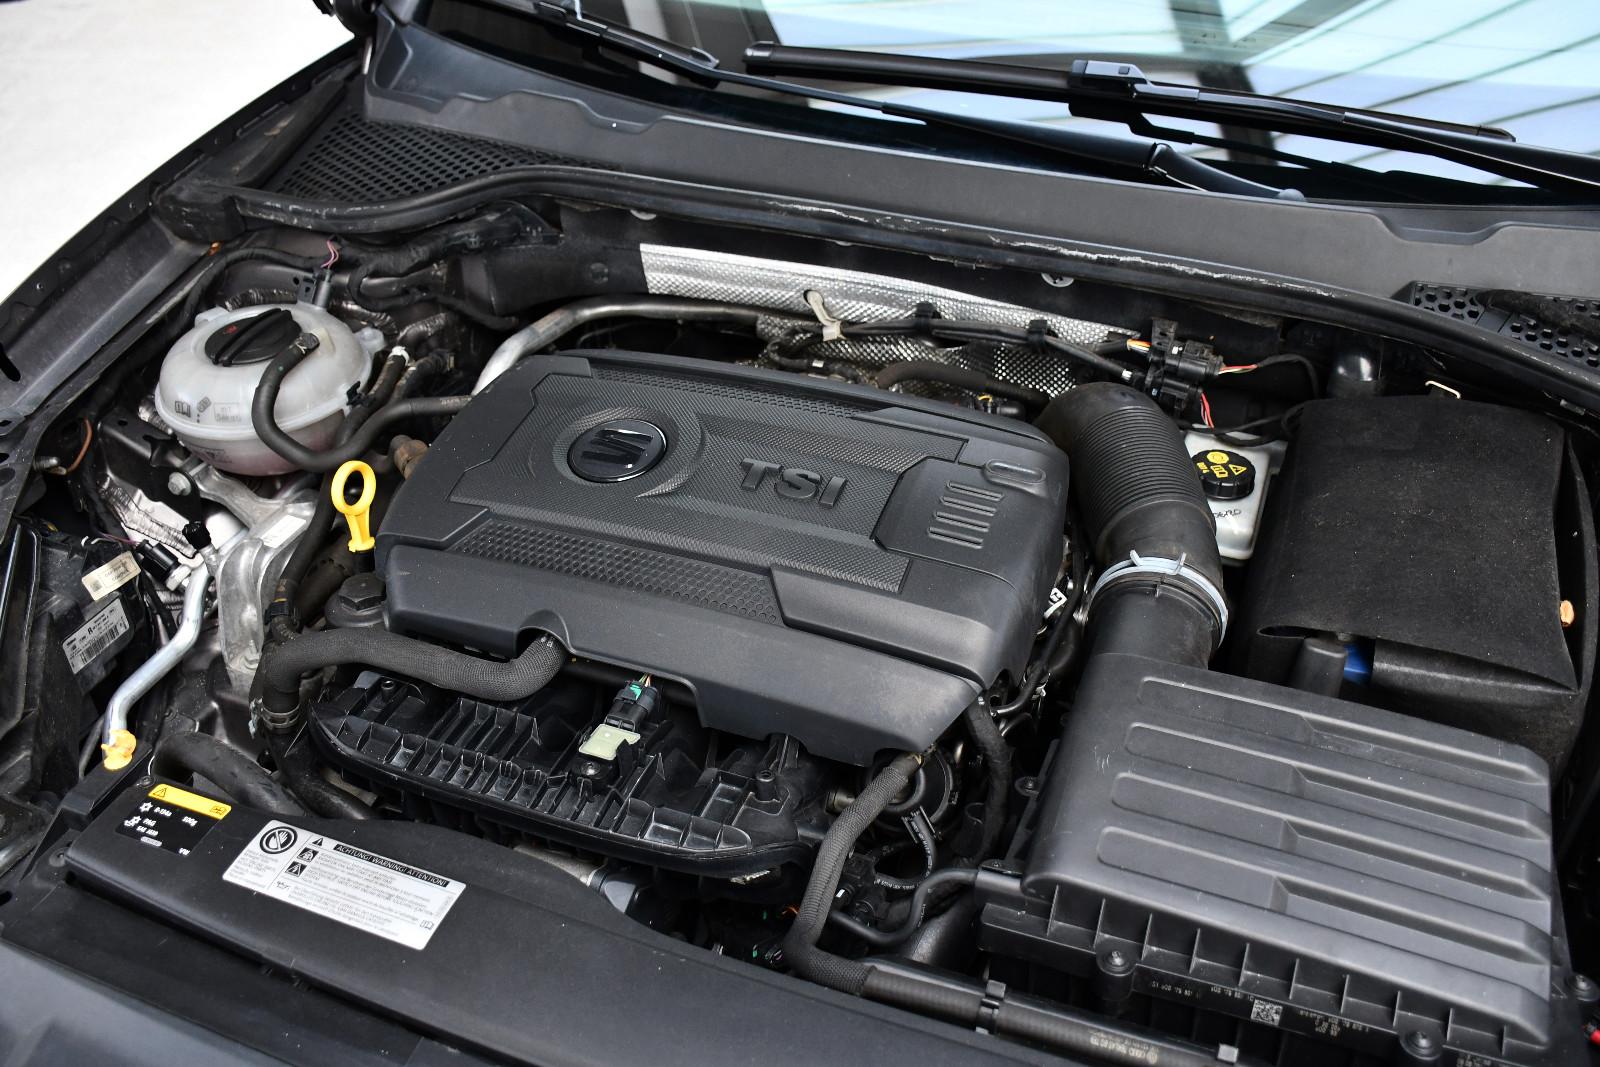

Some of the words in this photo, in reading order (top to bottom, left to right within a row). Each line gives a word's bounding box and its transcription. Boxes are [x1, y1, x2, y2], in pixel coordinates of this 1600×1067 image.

[740, 458, 848, 509] TSI
[336, 845, 371, 861] ACHTUNG!
[371, 857, 407, 873] WARNING!
[406, 869, 447, 886] ATTENTION!
